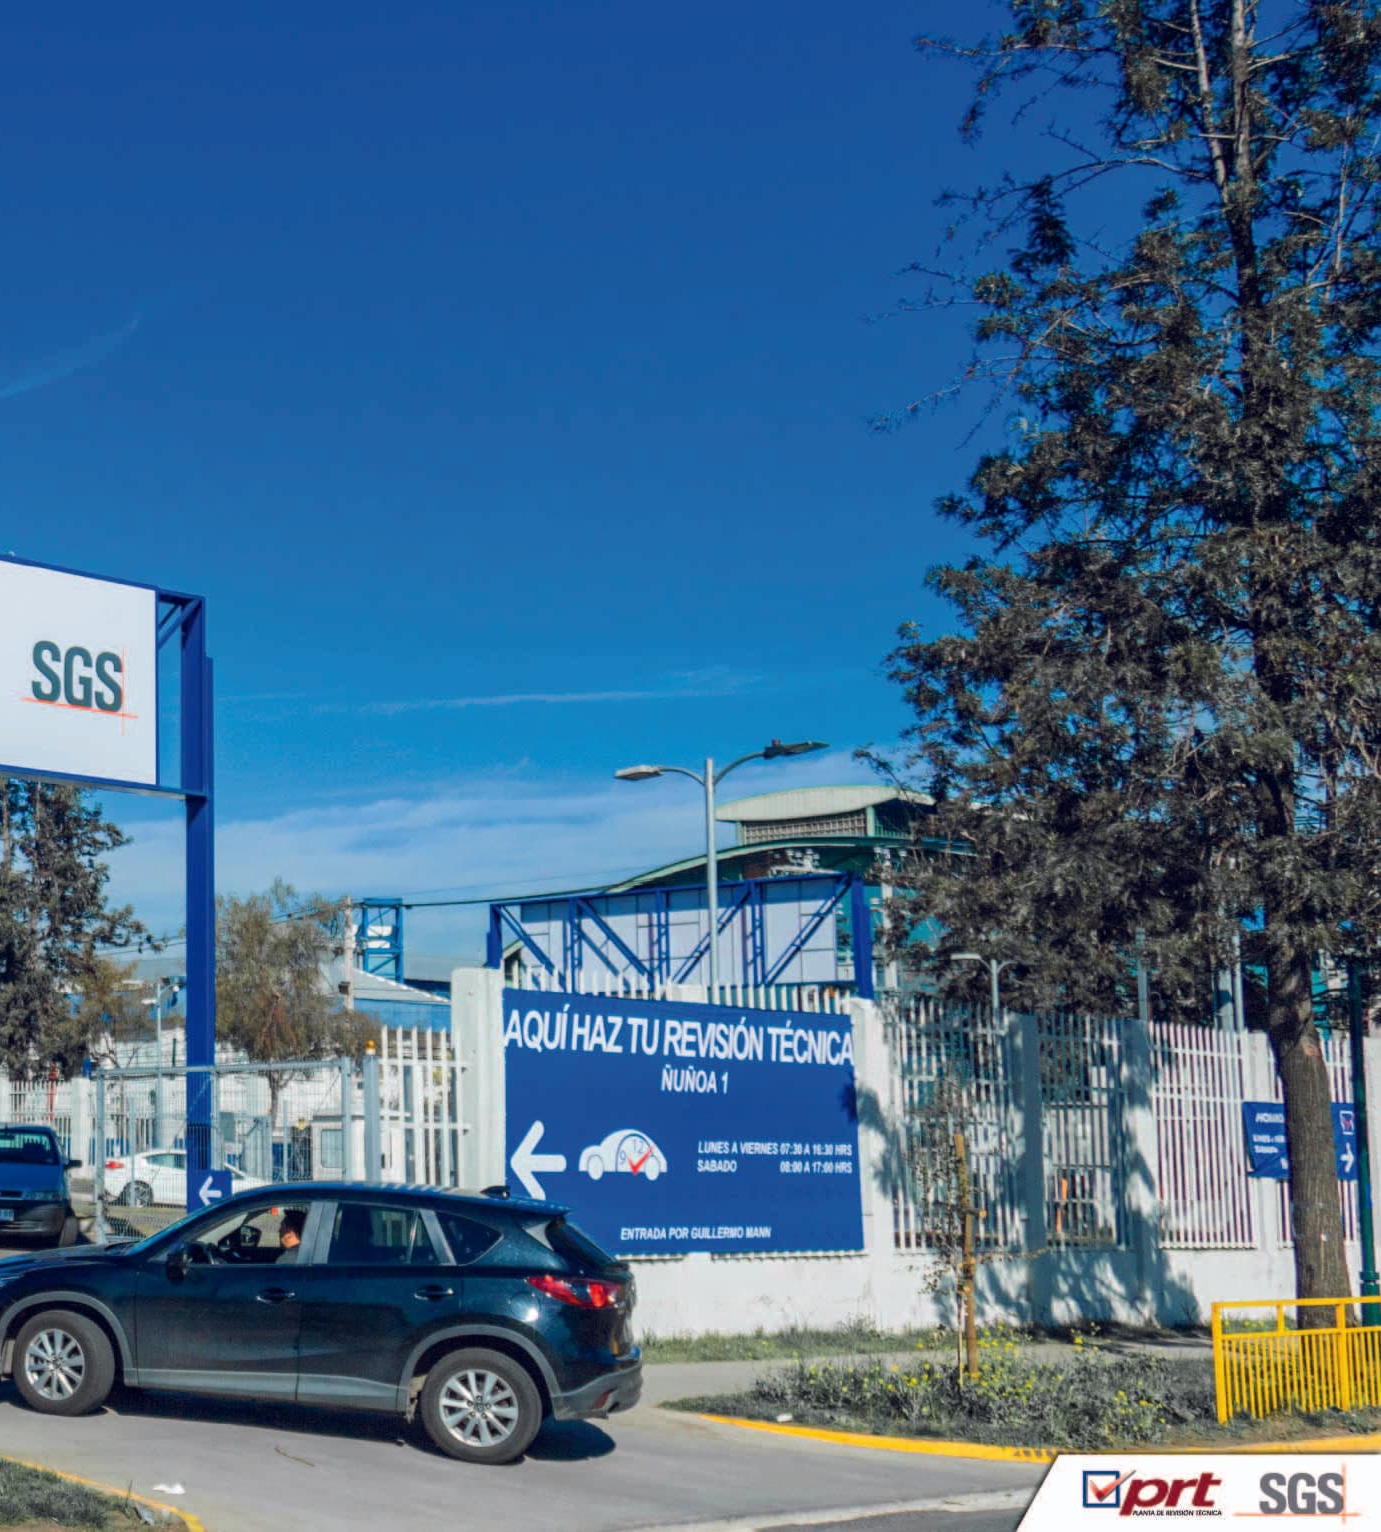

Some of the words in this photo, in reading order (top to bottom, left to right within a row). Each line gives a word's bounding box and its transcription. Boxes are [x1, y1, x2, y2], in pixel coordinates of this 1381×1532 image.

[31, 640, 123, 713] SGS
[503, 1004, 570, 1053] AQUÍ
[571, 1013, 623, 1053] HAZ
[627, 1017, 660, 1055] TU
[663, 1016, 763, 1061] REVISIÓN
[767, 1020, 854, 1066] TÉCNICA
[661, 1064, 717, 1093] ÑUÑOA
[721, 1072, 728, 1094] 1
[698, 1141, 729, 1154] LUNES
[731, 1142, 738, 1154] A
[740, 1142, 778, 1155] VIERNES
[780, 1143, 802, 1155] 07:30
[803, 1144, 810, 1155] A
[835, 1144, 852, 1156] HRS
[697, 1160, 737, 1173] SABADO
[803, 1162, 810, 1173] A
[835, 1162, 853, 1174] HRS
[621, 1227, 666, 1241] ENTRADA
[668, 1227, 689, 1239] POR
[691, 1226, 744, 1239] GUILLERMO
[745, 1226, 772, 1238] MANN
